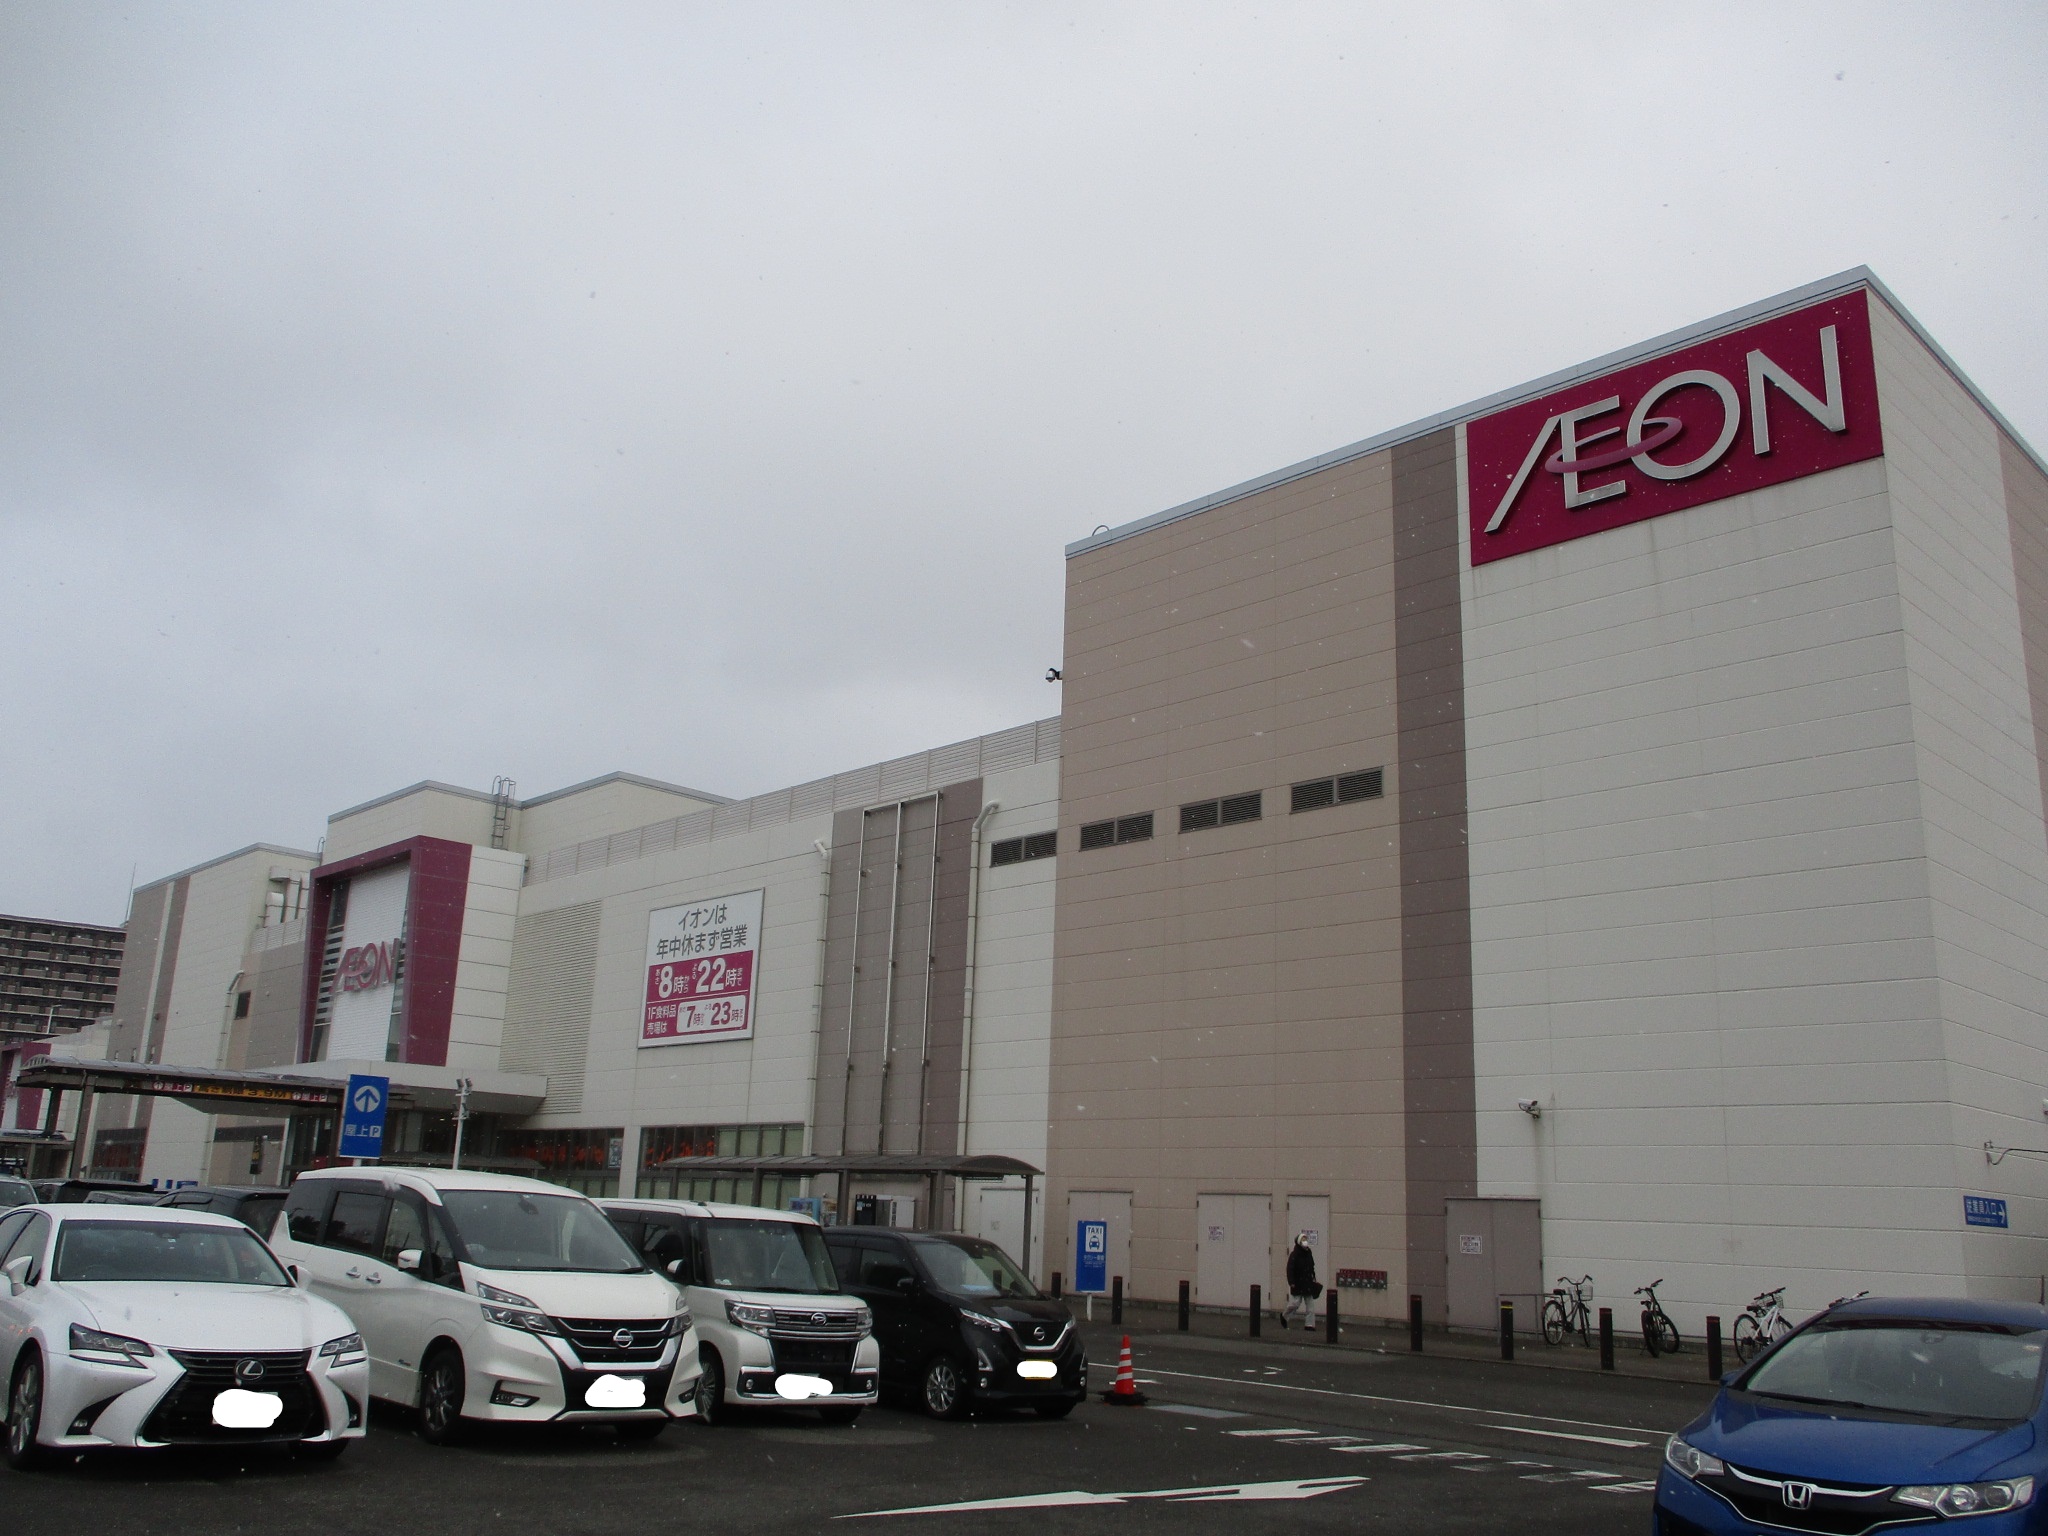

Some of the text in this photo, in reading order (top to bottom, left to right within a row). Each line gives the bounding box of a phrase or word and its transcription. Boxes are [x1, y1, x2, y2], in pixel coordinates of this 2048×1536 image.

[678, 903, 728, 931] イオンは
[656, 924, 748, 959] 年中休まず営業
[646, 1020, 668, 1035] 売場は
[1088, 1226, 1102, 1234] TAXI
